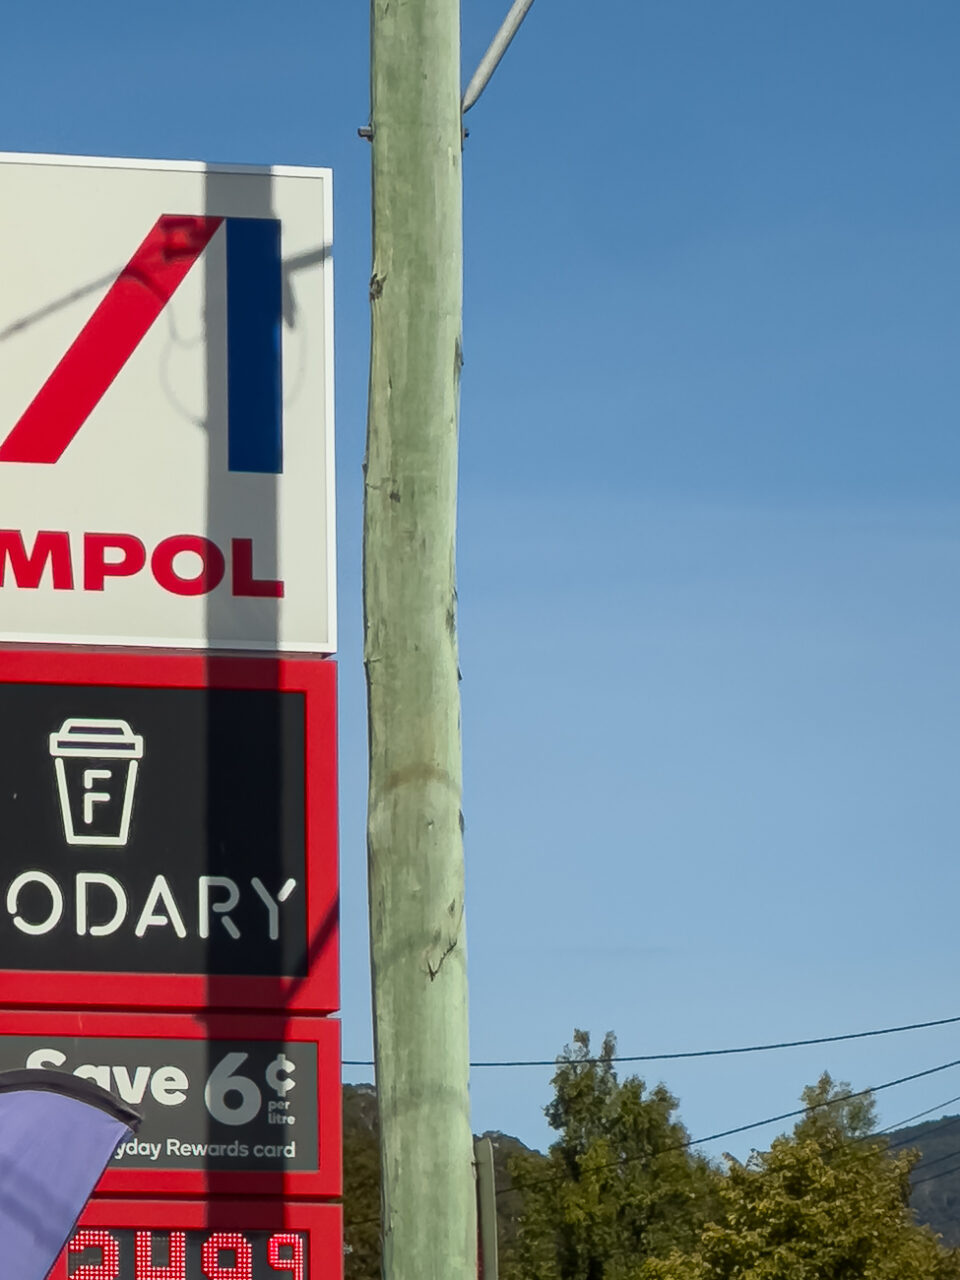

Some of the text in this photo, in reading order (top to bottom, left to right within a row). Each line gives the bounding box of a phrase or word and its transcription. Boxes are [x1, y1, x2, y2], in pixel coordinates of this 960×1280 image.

[84, 770, 112, 824] F
[268, 1101, 290, 1112] per
[268, 1113, 296, 1125] litre
[114, 1139, 296, 1161] yday Rewards card
